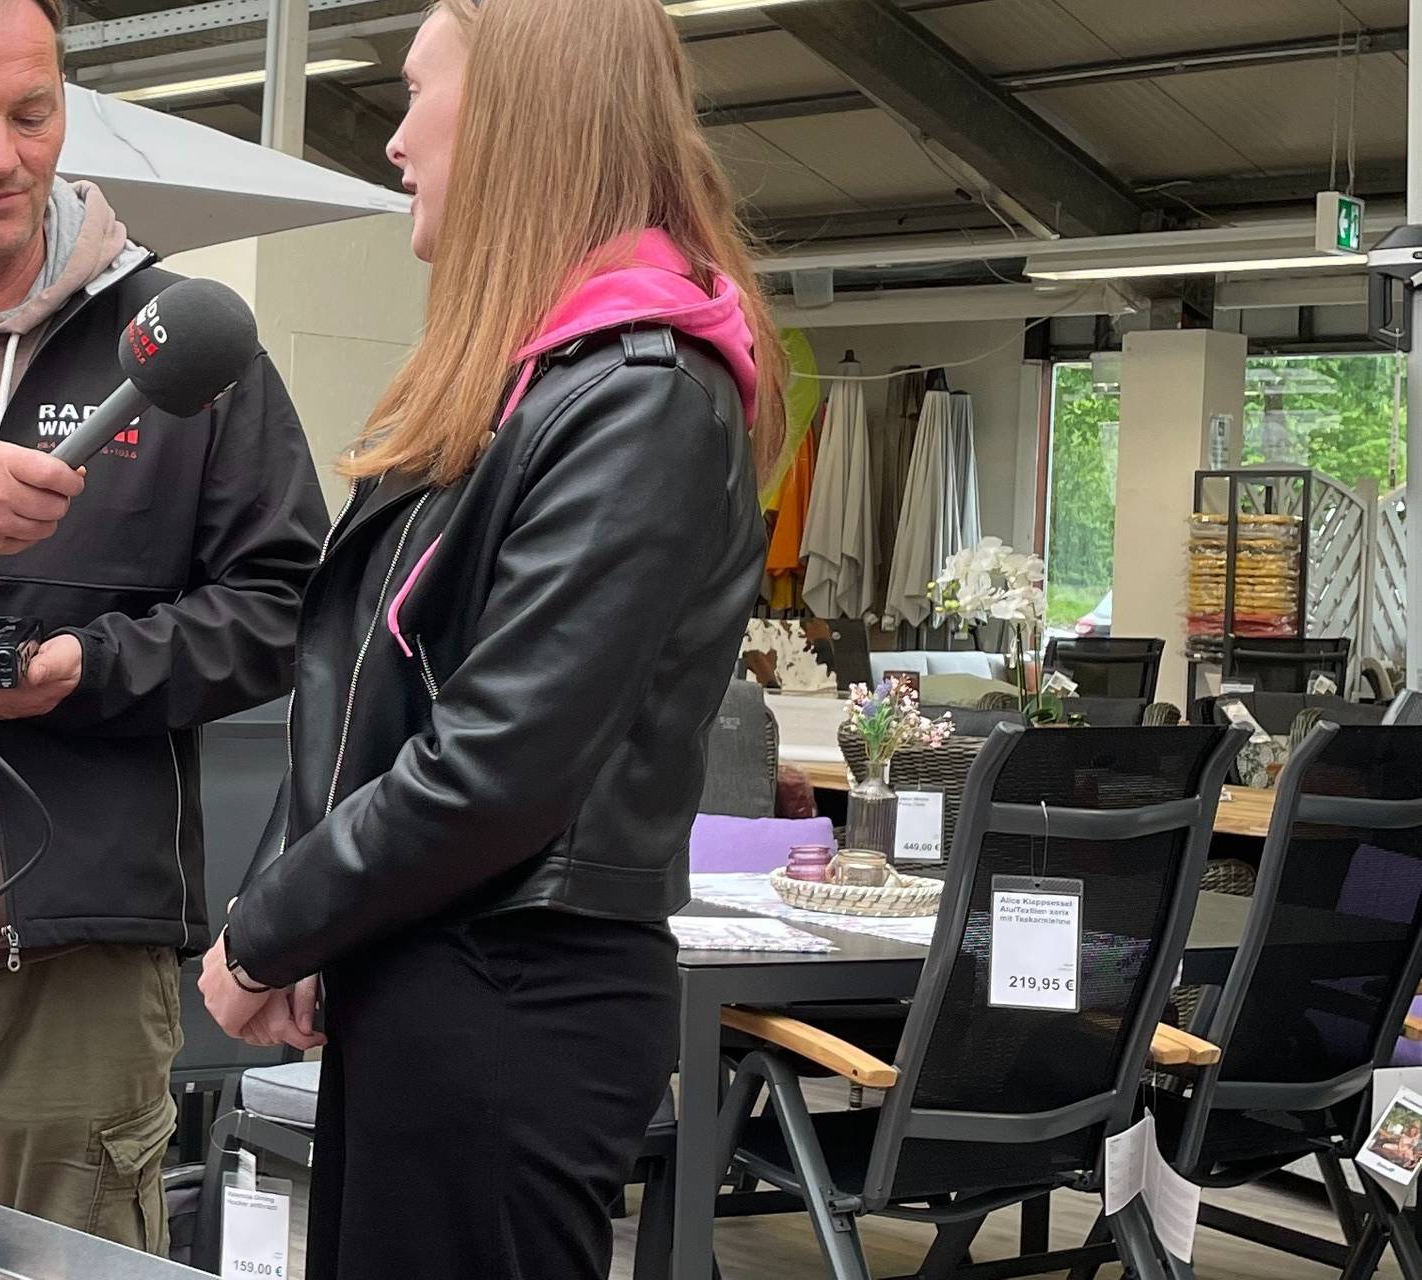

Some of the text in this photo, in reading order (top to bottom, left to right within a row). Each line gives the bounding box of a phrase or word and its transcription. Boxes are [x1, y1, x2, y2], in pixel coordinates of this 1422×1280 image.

[38, 420, 83, 436] WM
[1009, 976, 1074, 991] 219,95 €
[276, 1266, 283, 1277] €
